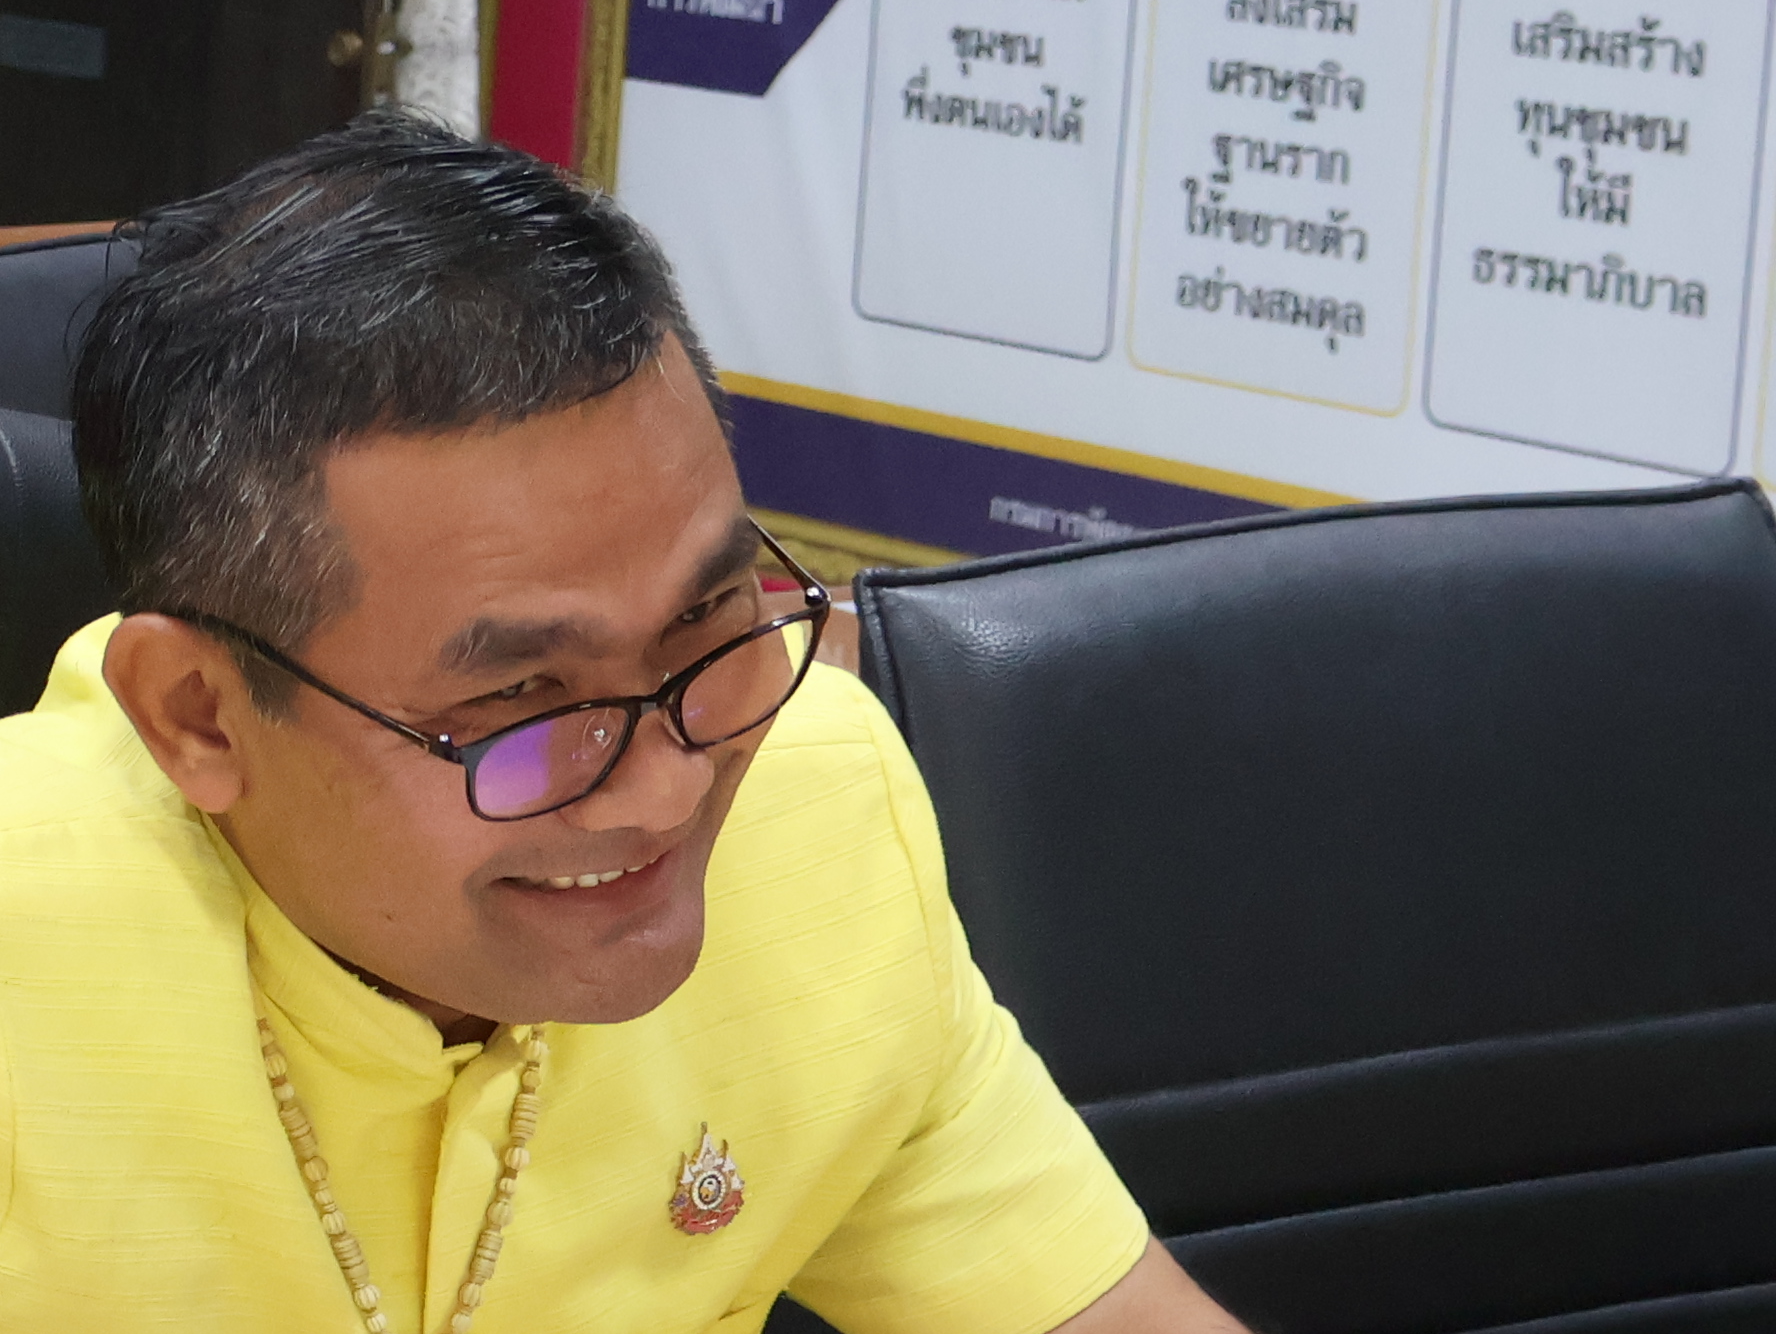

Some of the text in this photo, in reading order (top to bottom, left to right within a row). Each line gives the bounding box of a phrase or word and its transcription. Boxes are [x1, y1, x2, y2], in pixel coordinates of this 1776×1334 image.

[950, 24, 1047, 77] ชุมชน
[1510, 9, 1708, 78] เสริมสร้าง
[901, 66, 1087, 145] พึ่งตนเองได้
[1208, 57, 1366, 123] เศรษฐกิจ
[1210, 131, 1351, 187] ฐานราก
[1514, 97, 1691, 171] ทุนชุมชน
[1182, 175, 1368, 264] ให้ขยายตัว
[1555, 154, 1635, 227] ให้มี
[1176, 265, 1367, 355] อย่างสมดุล
[1471, 246, 1709, 319] ธรรมาภิบาล
